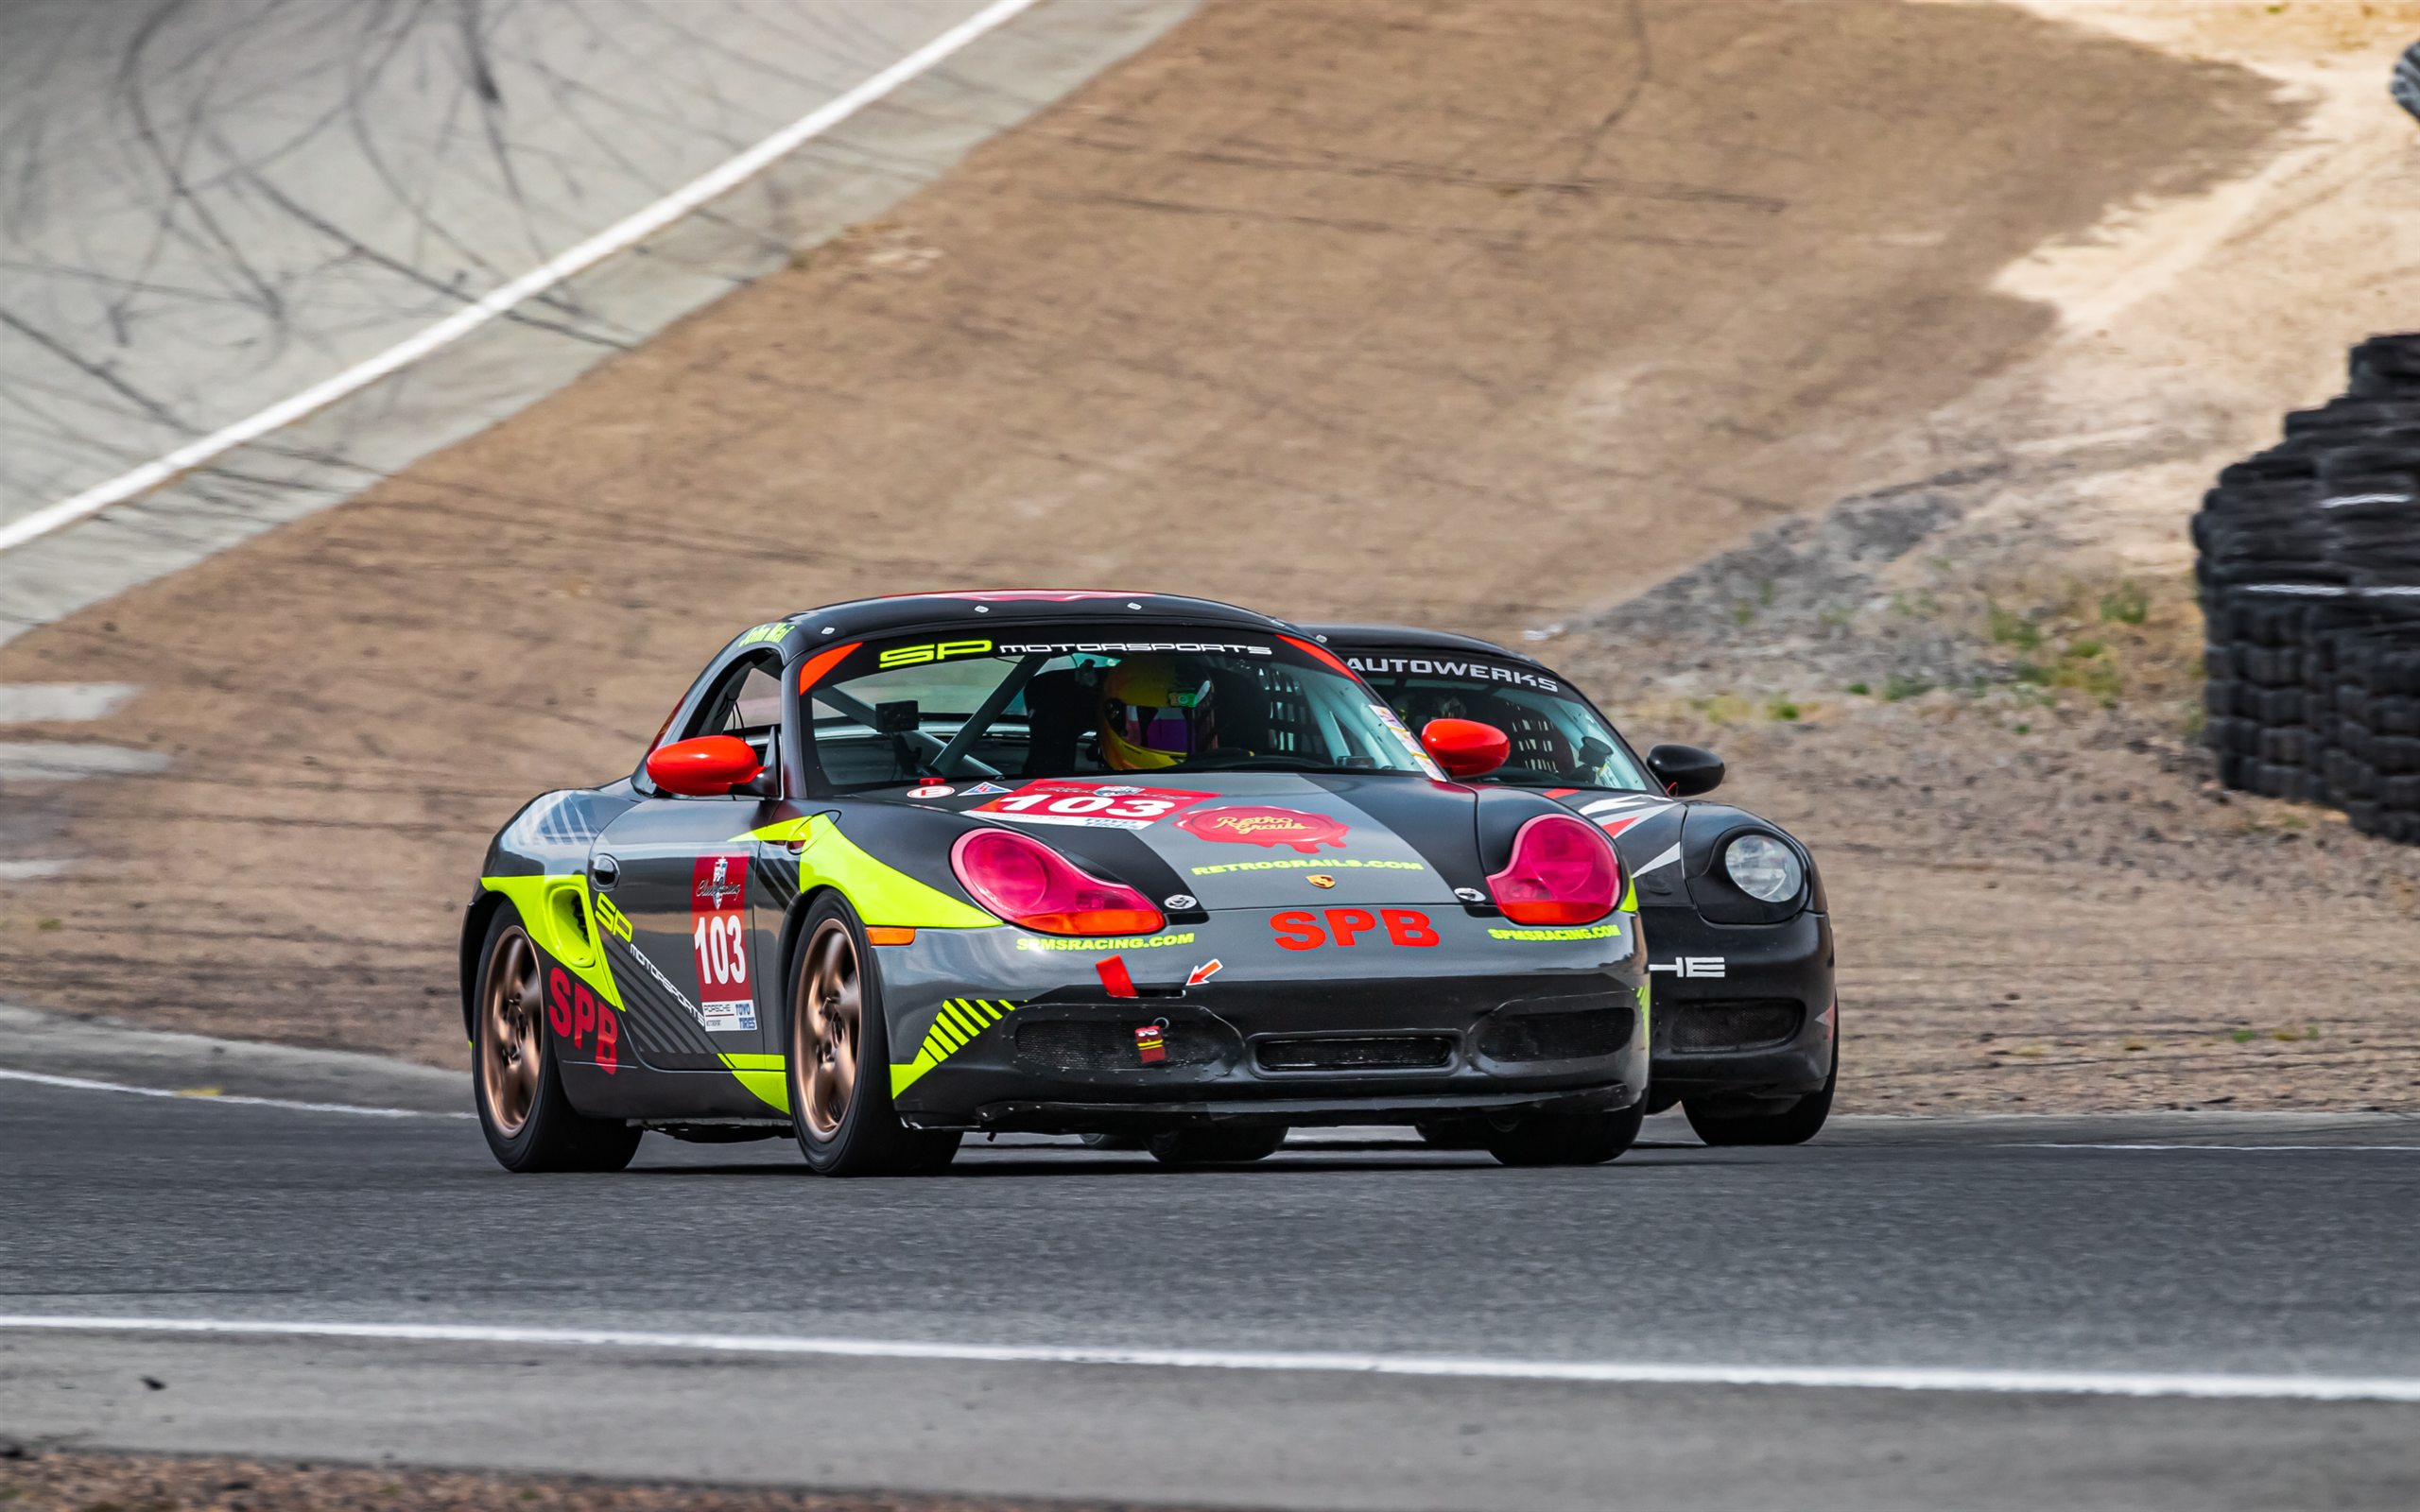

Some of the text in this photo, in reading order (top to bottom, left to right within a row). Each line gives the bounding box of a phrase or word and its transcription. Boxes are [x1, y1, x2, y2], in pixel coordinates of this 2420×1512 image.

[879, 640, 1272, 668] SP MOTORSPORTS
[1346, 658, 1558, 693] AUTOWERKS
[999, 794, 1175, 817] 103
[1191, 859, 1424, 876] RETROGRAILS.COM
[1015, 932, 1196, 952] SPMSRACING.COM
[1270, 908, 1441, 952] SPB
[1487, 924, 1622, 941] SPMSRACING.COM
[596, 892, 705, 1027] SP MOTORSPORTS
[694, 914, 747, 986] 103
[548, 967, 618, 1075] SPB
[735, 1003, 751, 1016] TOYO
